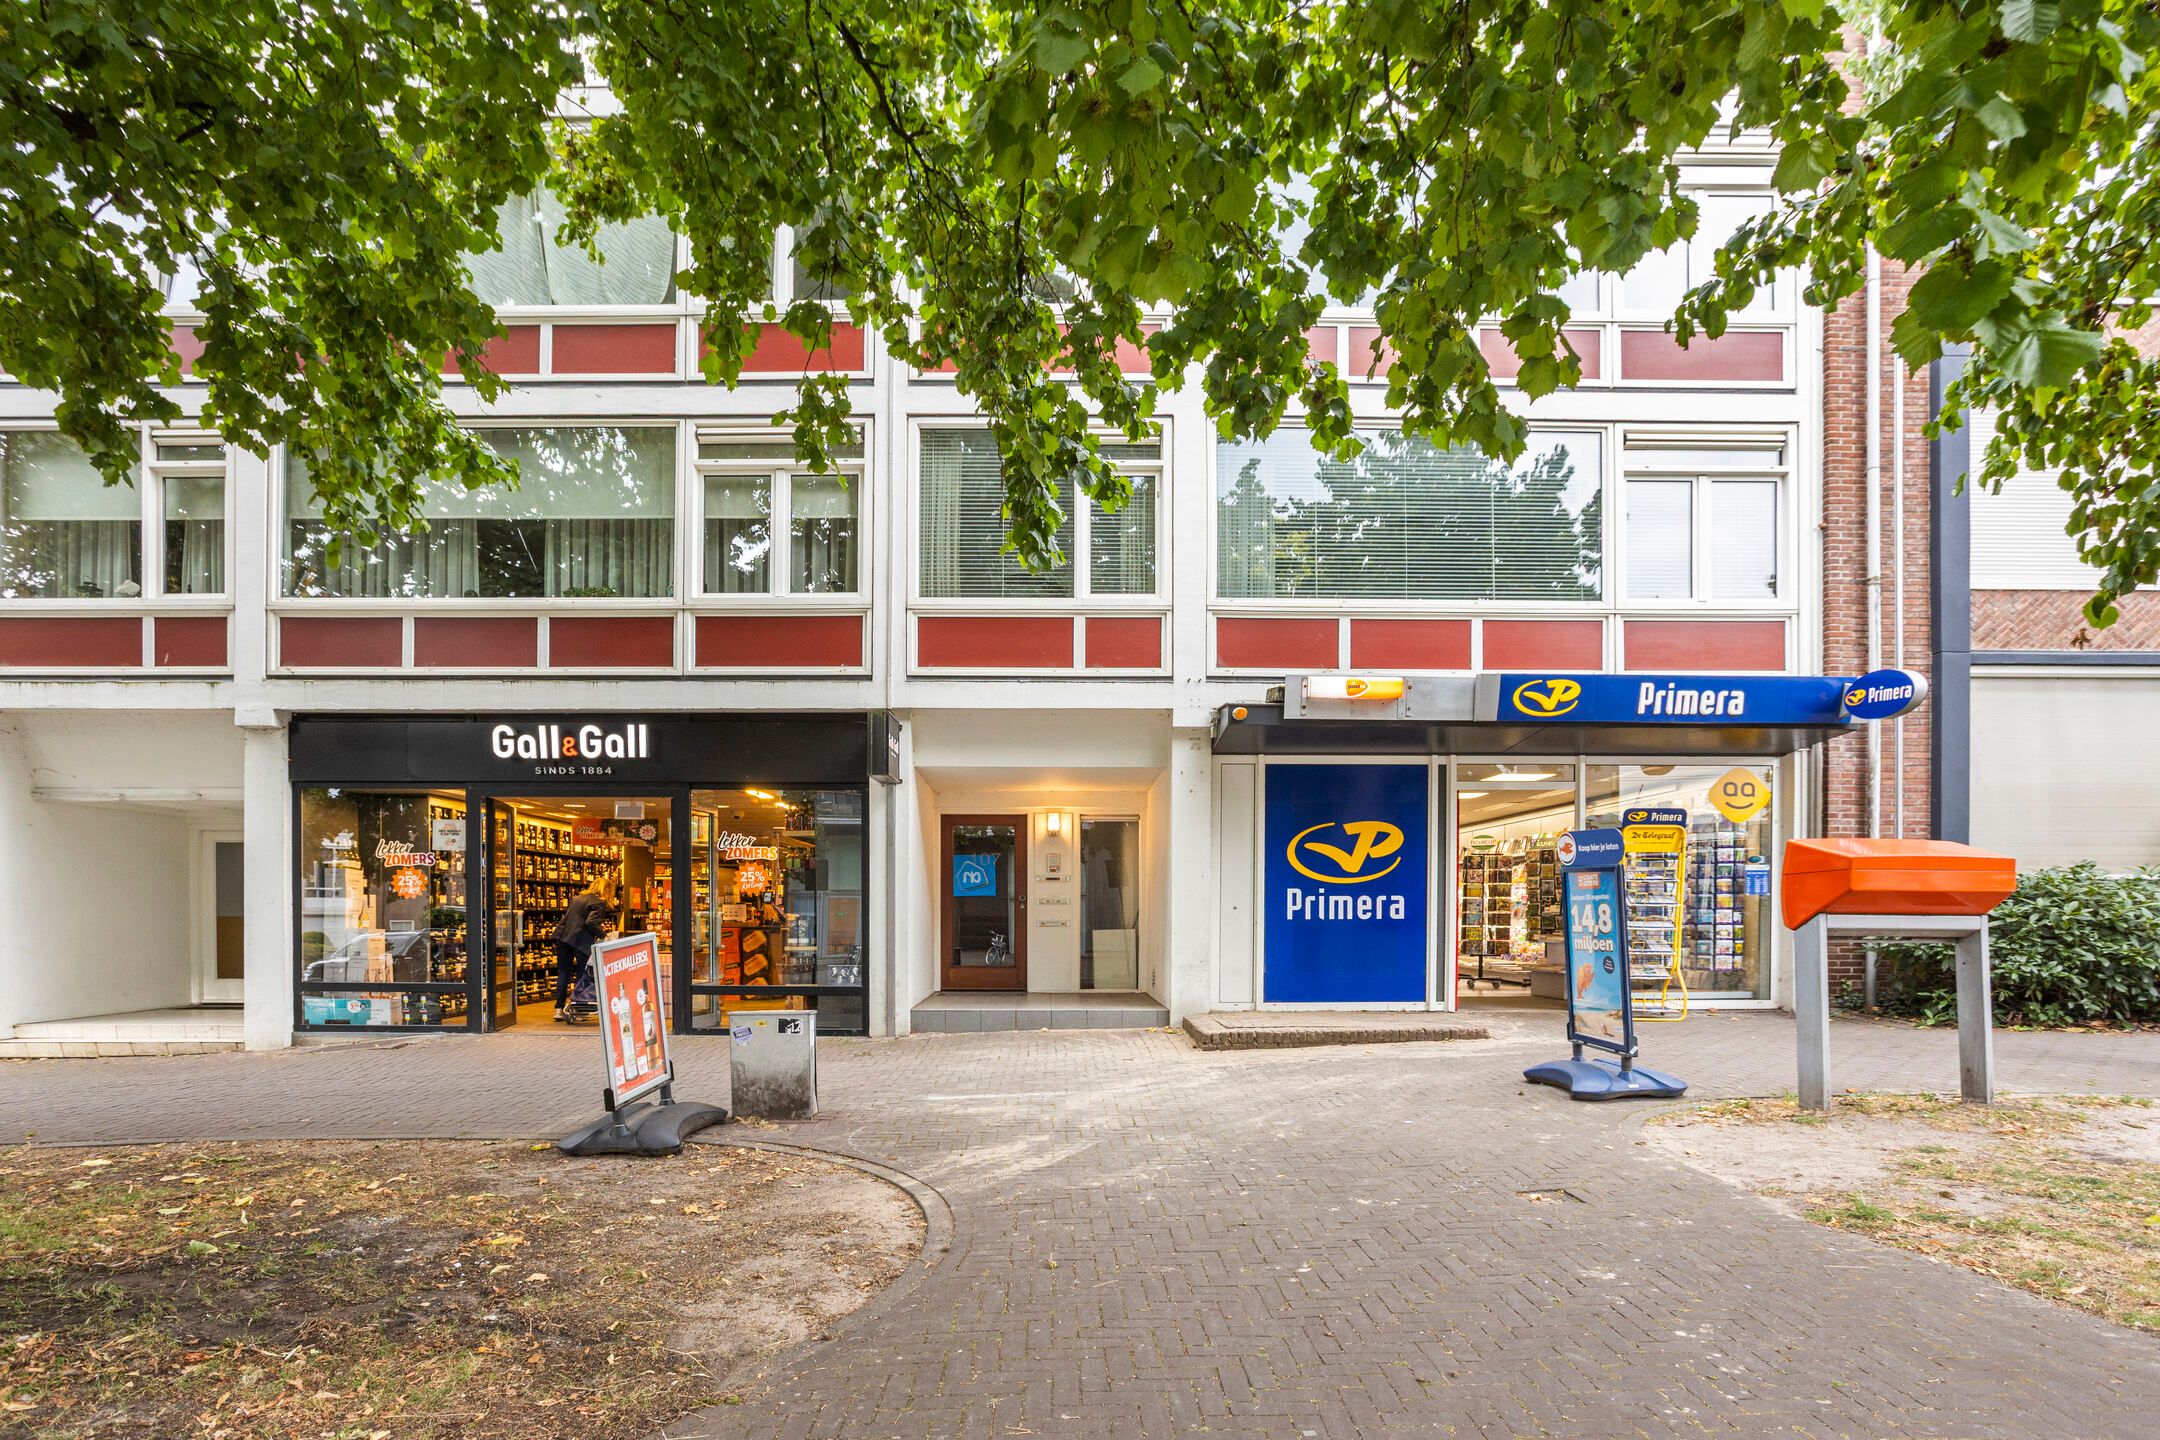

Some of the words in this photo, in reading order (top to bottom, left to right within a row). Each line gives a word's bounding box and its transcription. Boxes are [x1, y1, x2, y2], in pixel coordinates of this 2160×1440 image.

[1637, 682, 1745, 716] Primera
[1868, 685, 1912, 703] Primera
[492, 724, 648, 759] Gall&Gall
[535, 766, 576, 775] SINDS
[582, 766, 613, 775] 1884
[1651, 812, 1683, 822] Primera
[717, 831, 756, 850] Lekker
[1632, 831, 1642, 839] De
[1643, 831, 1677, 840] Telegraaf
[375, 839, 414, 858] Lekker
[726, 847, 778, 860] ZOMERS
[1578, 844, 1590, 852] Koop
[1600, 842, 1606, 852] je
[1606, 842, 1619, 850] loten
[384, 852, 435, 867] ZOMERS
[397, 876, 422, 887] 25%
[740, 871, 765, 882] 25%
[1286, 888, 1405, 920] Primera
[1571, 903, 1612, 938] 14,8
[1574, 936, 1614, 954] miljoen
